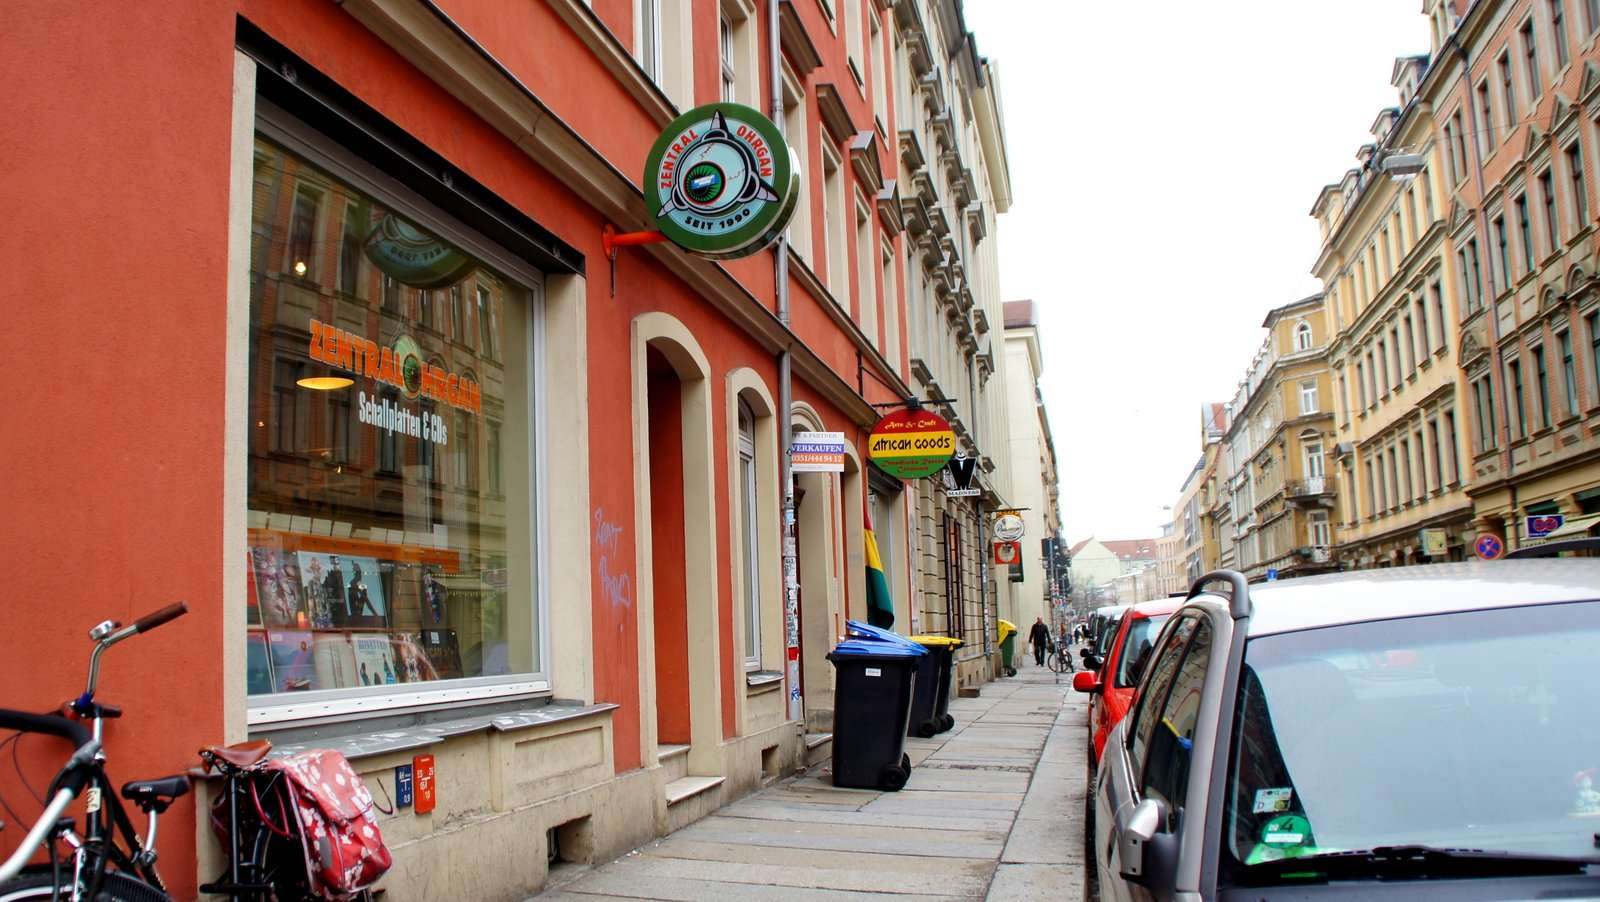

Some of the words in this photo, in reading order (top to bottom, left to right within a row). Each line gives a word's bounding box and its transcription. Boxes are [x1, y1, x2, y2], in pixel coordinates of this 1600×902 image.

[660, 129, 699, 189] ZENTRAL
[736, 125, 772, 178] OHRGAN
[684, 215, 715, 230] SEIT
[719, 208, 751, 229] 1990
[309, 318, 404, 388] ZENTRAL
[359, 391, 421, 438] Schallplatten
[422, 411, 431, 438] &
[430, 413, 448, 446] CDs
[791, 444, 842, 452] VERKAUFEN
[1280, 817, 1294, 832] 4
